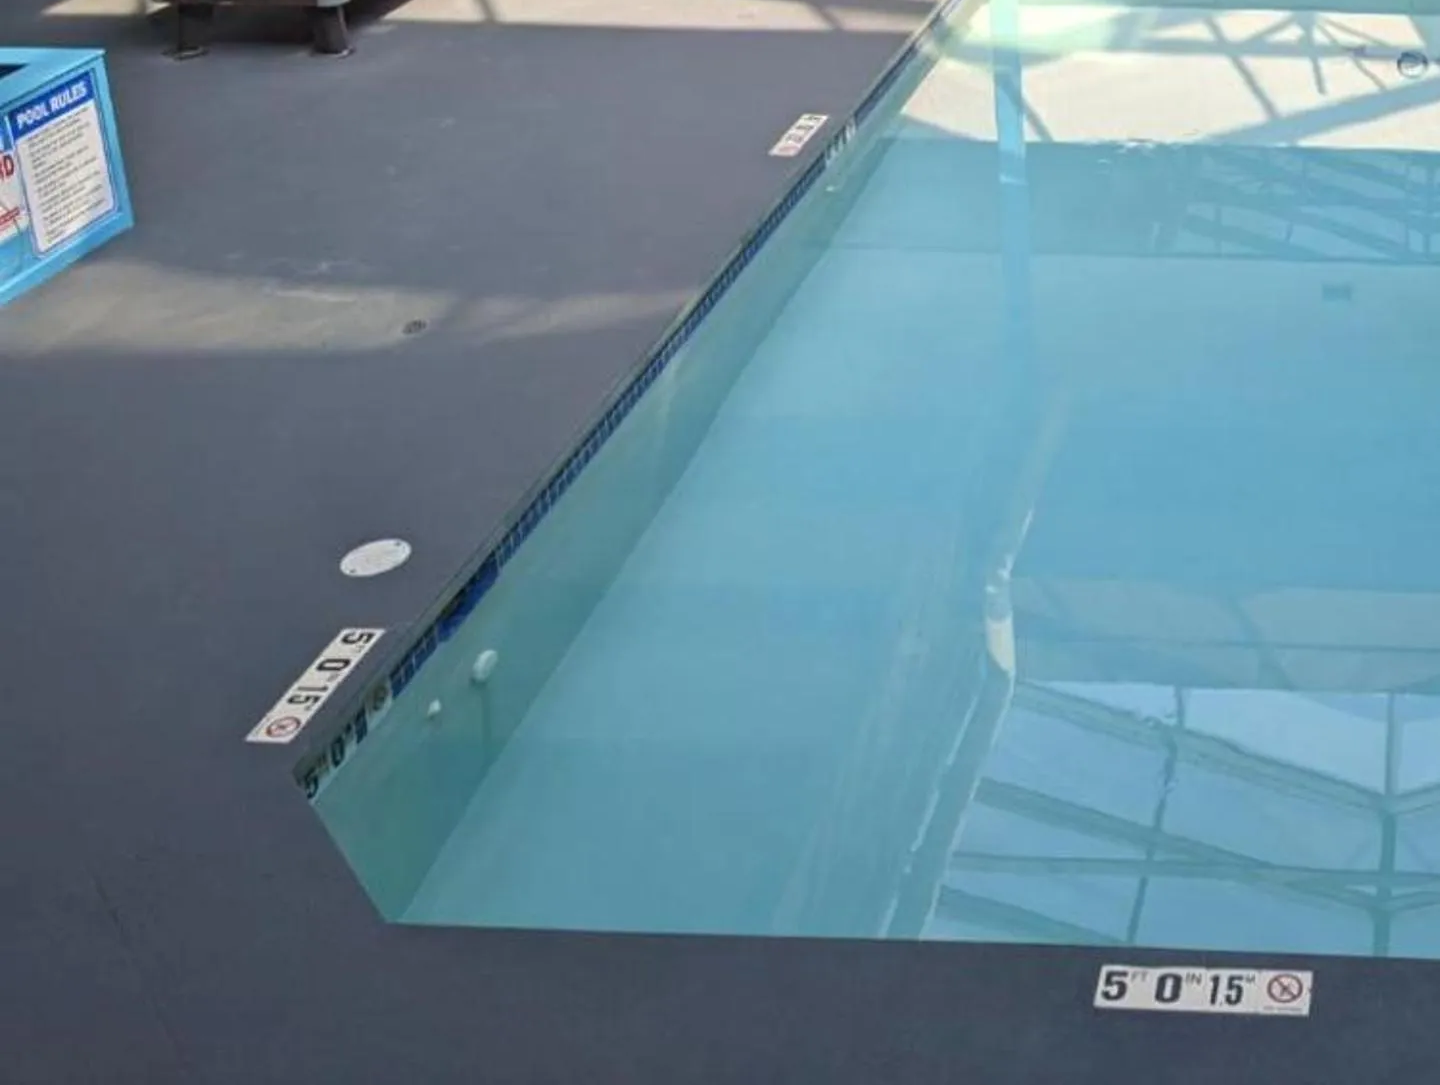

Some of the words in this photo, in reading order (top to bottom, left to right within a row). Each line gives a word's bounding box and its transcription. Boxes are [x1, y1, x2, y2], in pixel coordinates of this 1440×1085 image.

[16, 101, 50, 130] POOL
[49, 80, 87, 113] RULES
[1101, 970, 1129, 1002] 5
[1154, 973, 1183, 1004] 0
